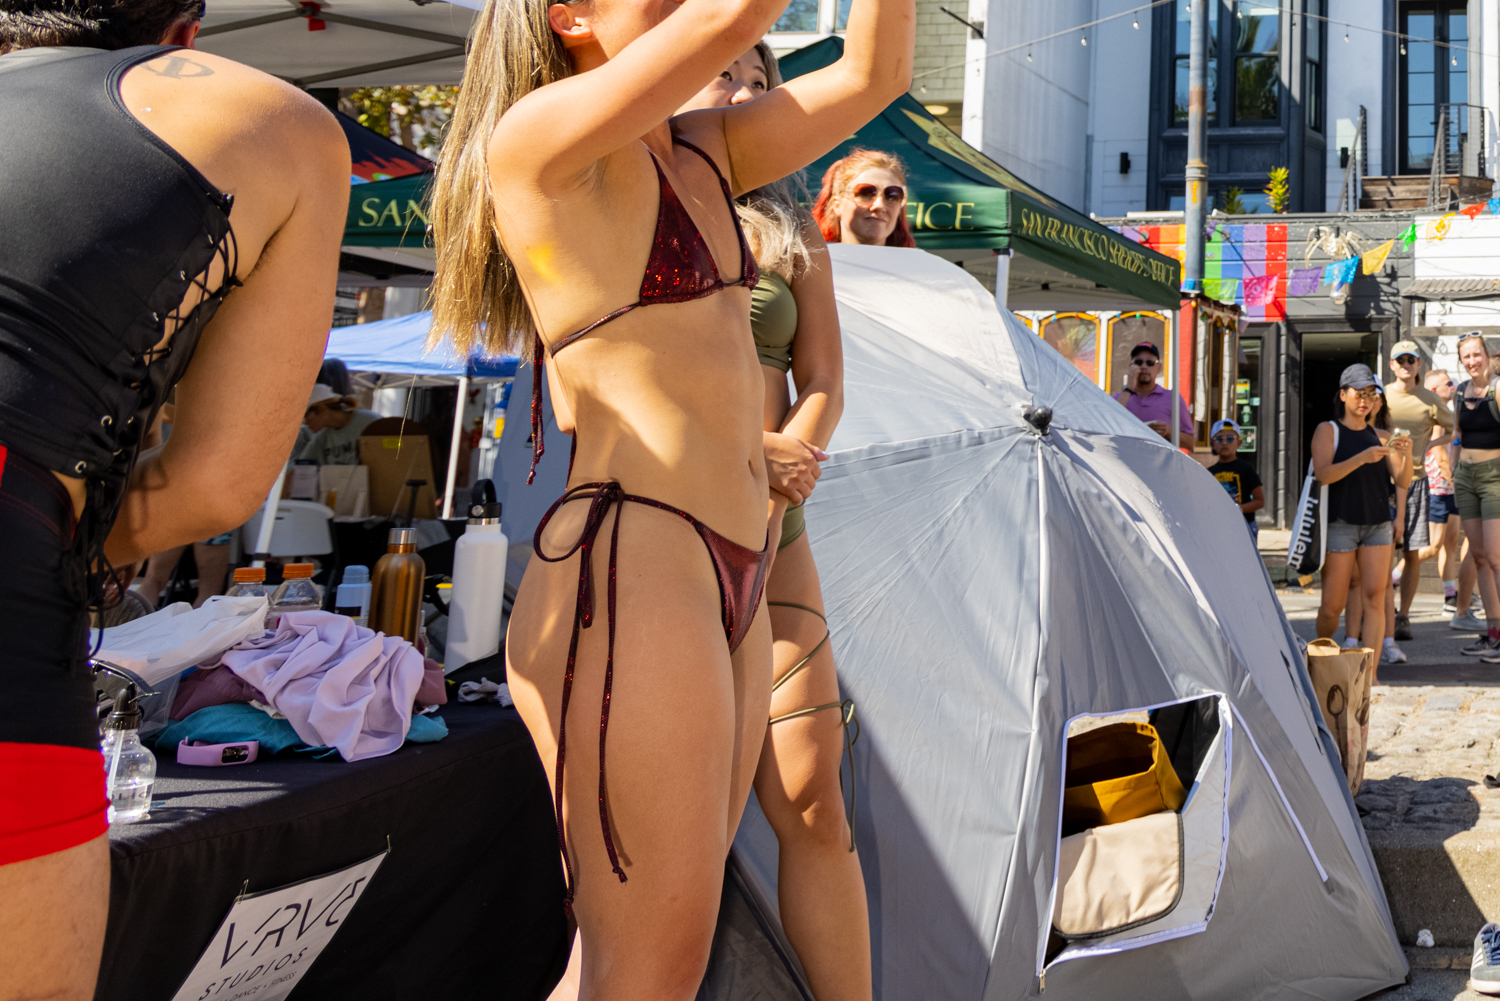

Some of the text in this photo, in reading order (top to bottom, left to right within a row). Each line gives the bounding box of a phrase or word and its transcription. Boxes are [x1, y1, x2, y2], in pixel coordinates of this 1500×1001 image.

[1021, 208, 1045, 238] SAN
[1045, 217, 1108, 260] FRANCISCO
[199, 947, 308, 1001] STUDIOS
